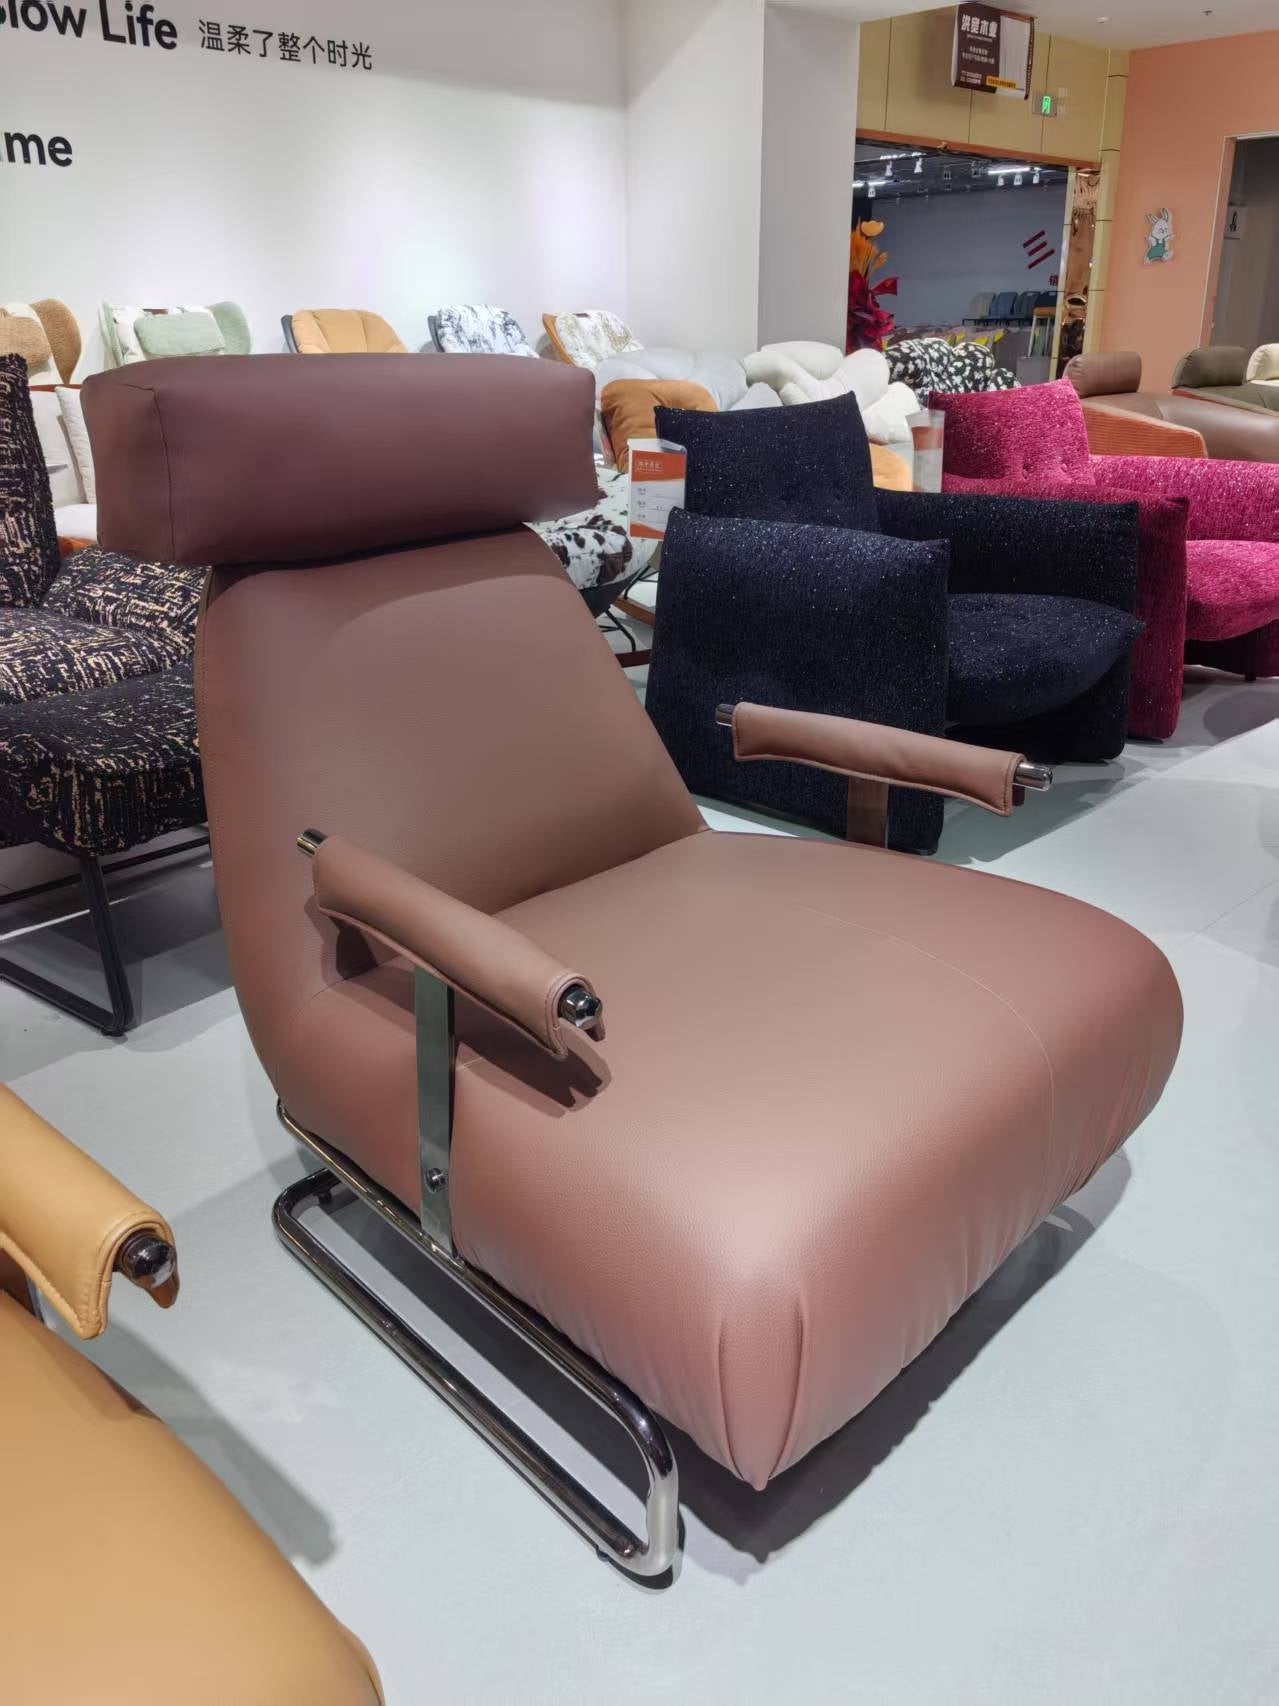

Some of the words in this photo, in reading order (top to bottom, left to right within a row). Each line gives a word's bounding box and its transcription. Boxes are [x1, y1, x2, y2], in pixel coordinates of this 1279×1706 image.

[98, 0, 178, 50] Life
[198, 19, 373, 70] 温柔了整个时光
[0, 131, 73, 167] me
